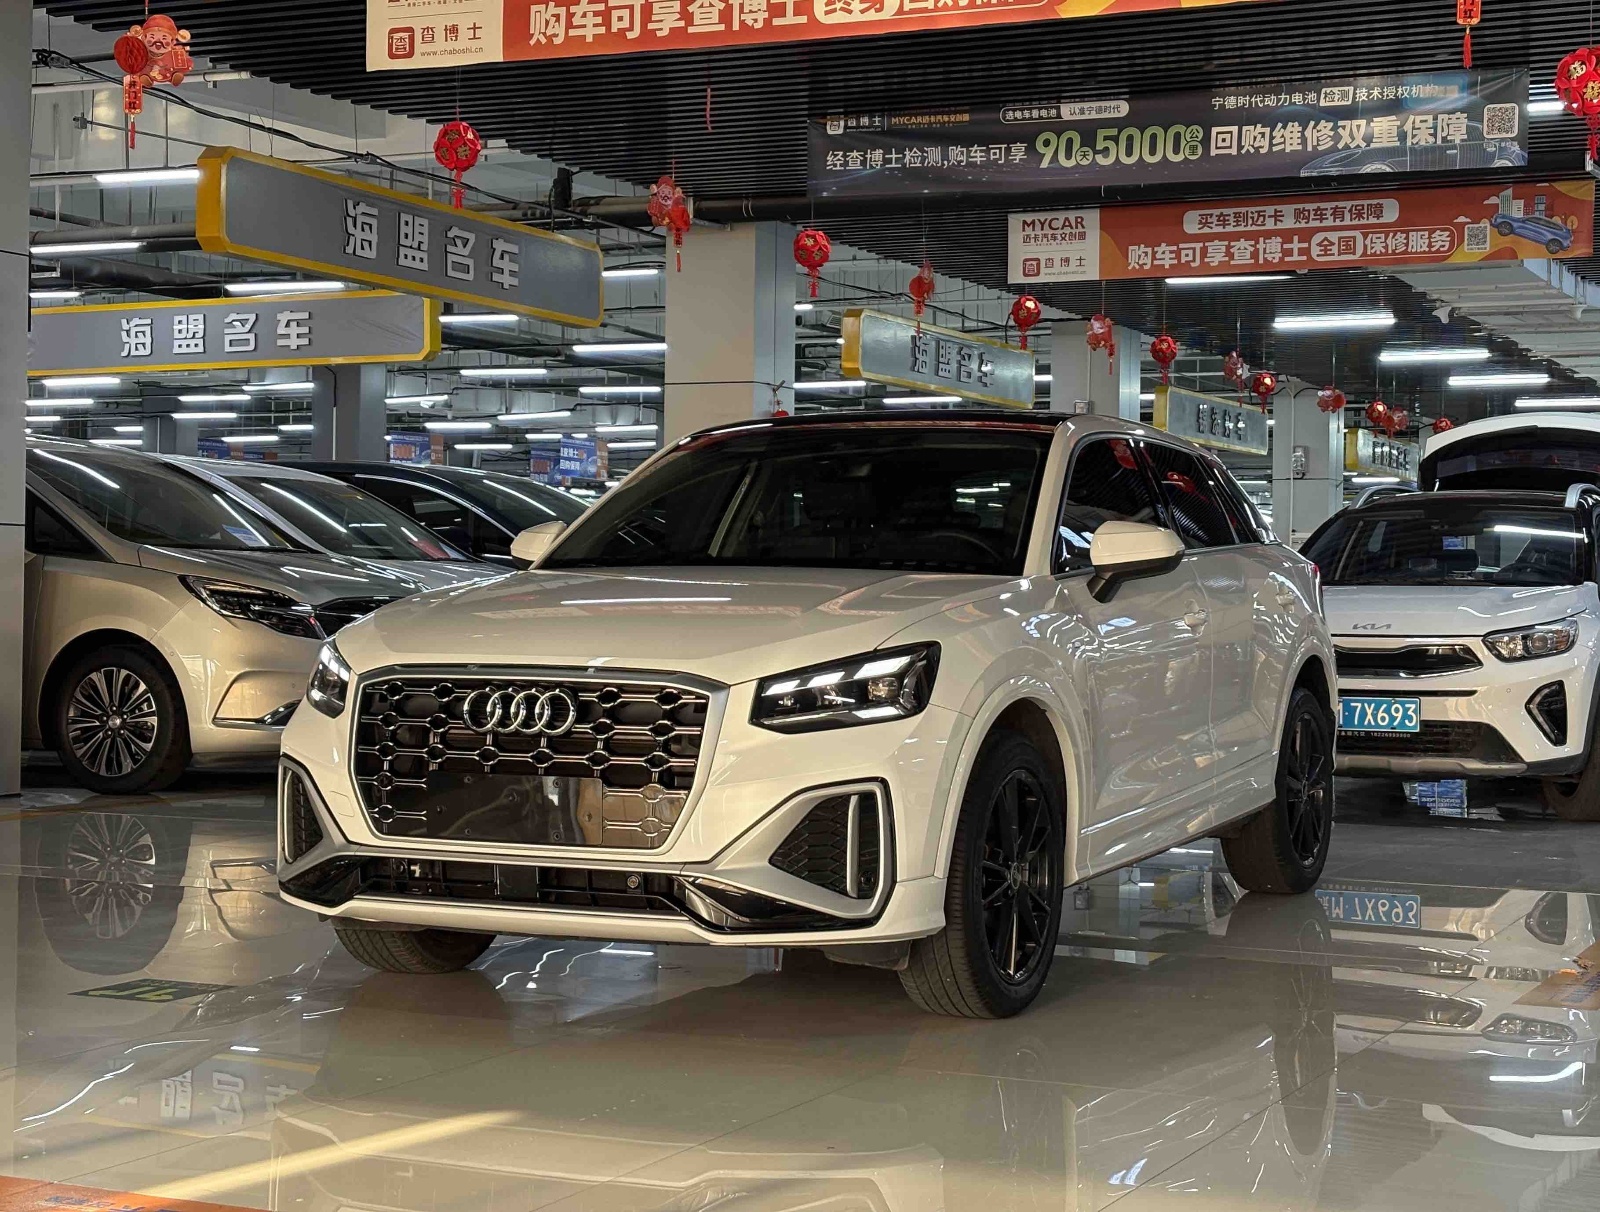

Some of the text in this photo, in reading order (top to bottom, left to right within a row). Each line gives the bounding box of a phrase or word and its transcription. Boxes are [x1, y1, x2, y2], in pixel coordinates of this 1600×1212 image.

[420, 22, 483, 45] 查博士
[420, 46, 483, 57] www.chaboshi.cn
[1005, 104, 1121, 120] 选电车看电池 认准宁德时代
[1210, 113, 1468, 157] 回购维修双重保障
[1022, 216, 1086, 232] MYCAR
[1198, 202, 1385, 231] 买车到迈卡 购车有保障
[343, 199, 520, 290] 海盟名车
[1044, 256, 1087, 268] 查博士
[120, 310, 311, 358] 海盟名车
[1352, 623, 1392, 631] KIA
